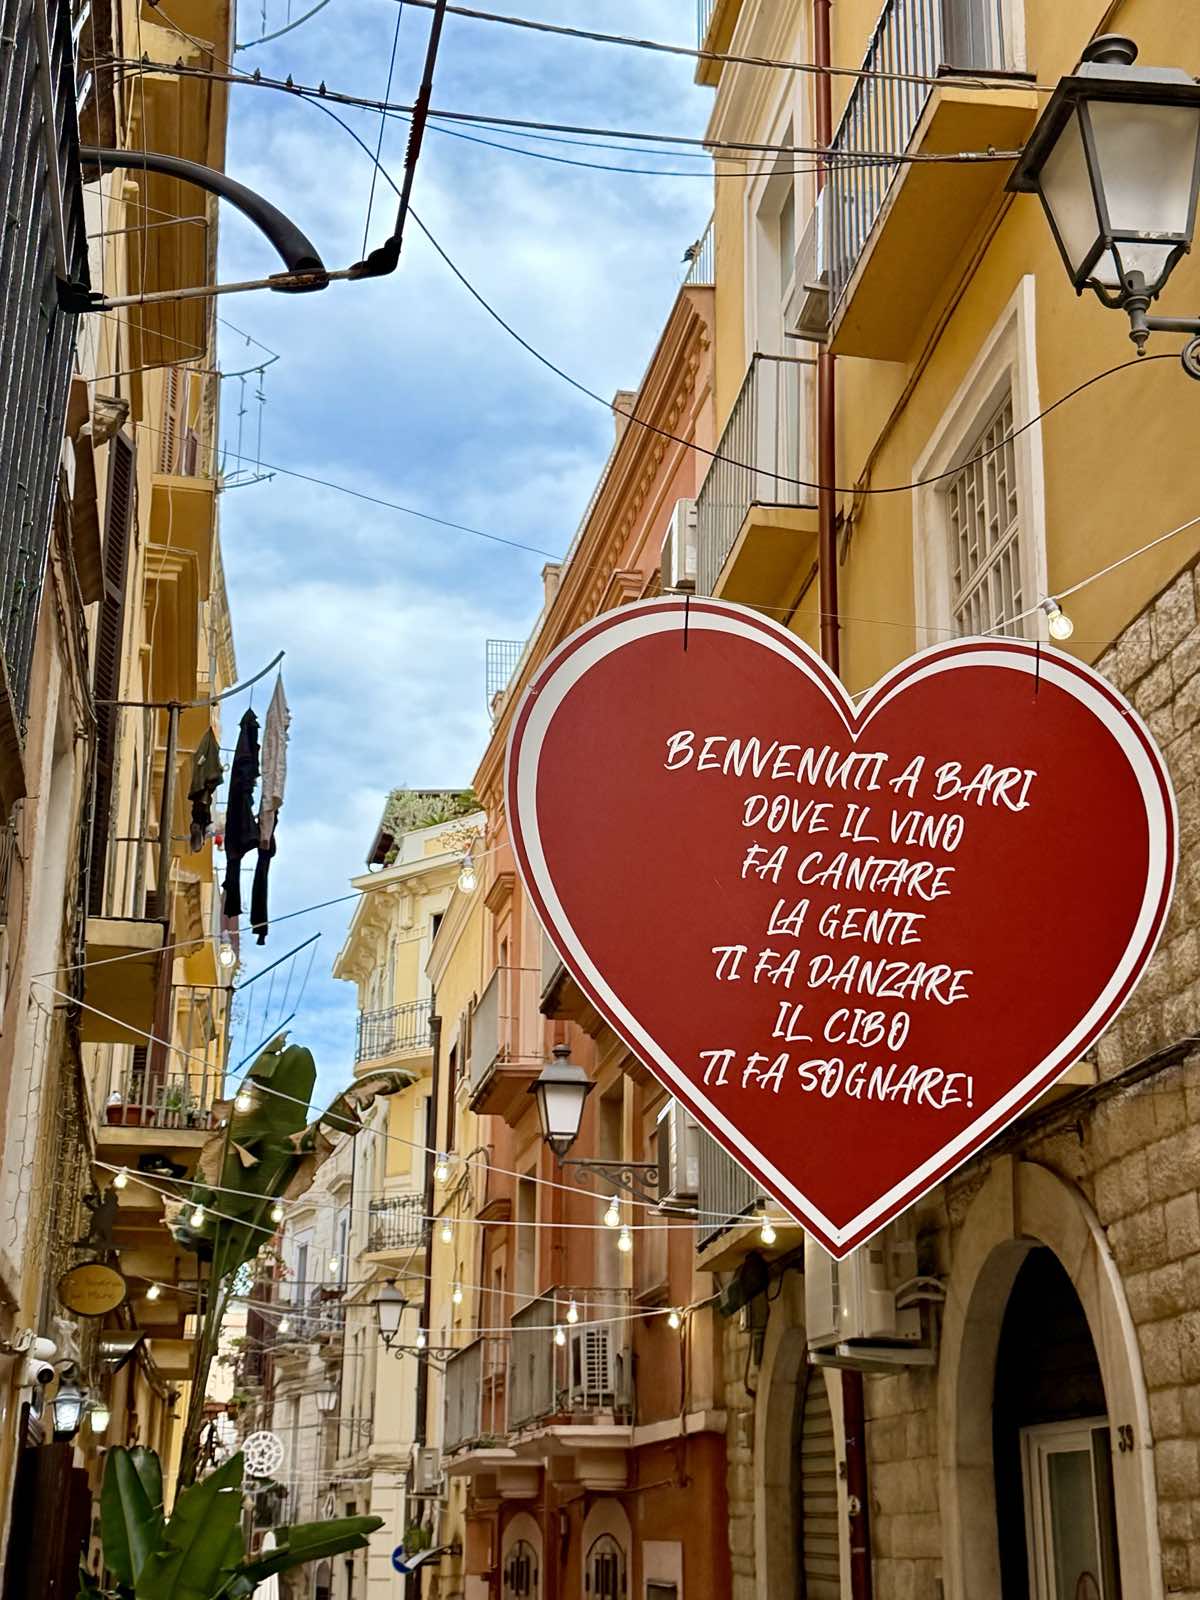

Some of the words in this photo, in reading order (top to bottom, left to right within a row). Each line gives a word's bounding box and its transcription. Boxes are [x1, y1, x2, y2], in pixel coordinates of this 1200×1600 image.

[664, 730, 889, 791] BENVENUTI
[889, 755, 926, 798] A
[933, 761, 1038, 812] BARI
[741, 794, 834, 834] DOVE
[839, 803, 880, 843] IL
[890, 809, 965, 852] VINO
[741, 843, 788, 884] FA
[797, 851, 956, 902] CANTARE
[766, 898, 810, 938] LA
[818, 903, 926, 945] GENTE
[711, 944, 748, 981] TI
[753, 947, 801, 988] FA
[807, 954, 974, 1006] DANZARE
[771, 1001, 813, 1042] IL
[823, 1008, 910, 1052] CIBO
[699, 1048, 736, 1086] TI
[742, 1051, 790, 1094] FA
[797, 1057, 974, 1110] SOGNARE!
